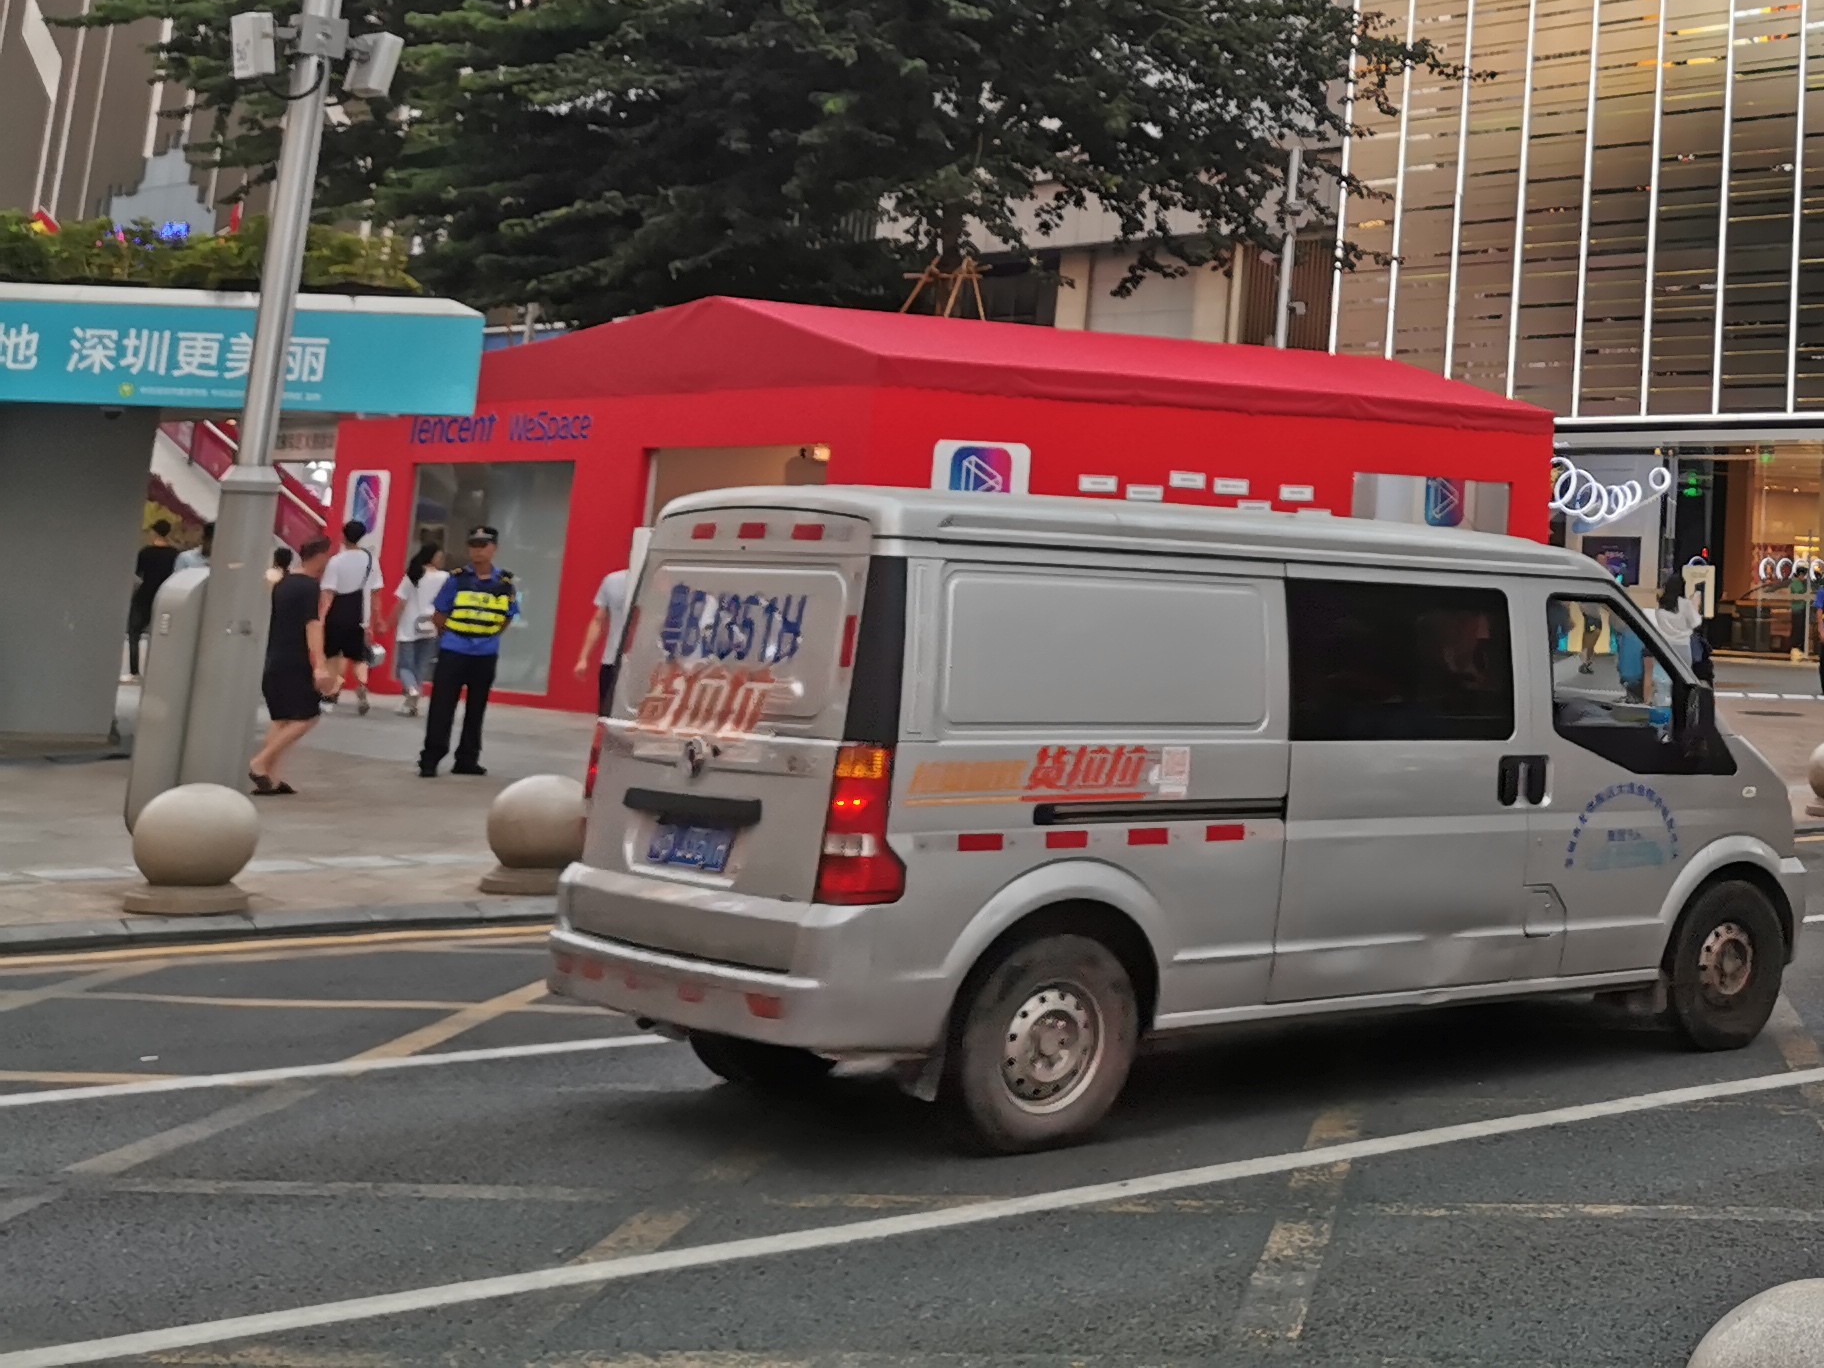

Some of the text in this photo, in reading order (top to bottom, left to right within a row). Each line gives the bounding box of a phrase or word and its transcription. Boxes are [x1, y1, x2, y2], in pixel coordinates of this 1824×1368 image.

[509, 411, 593, 443] WeSpace
[1025, 745, 1158, 791] 货拉拉
